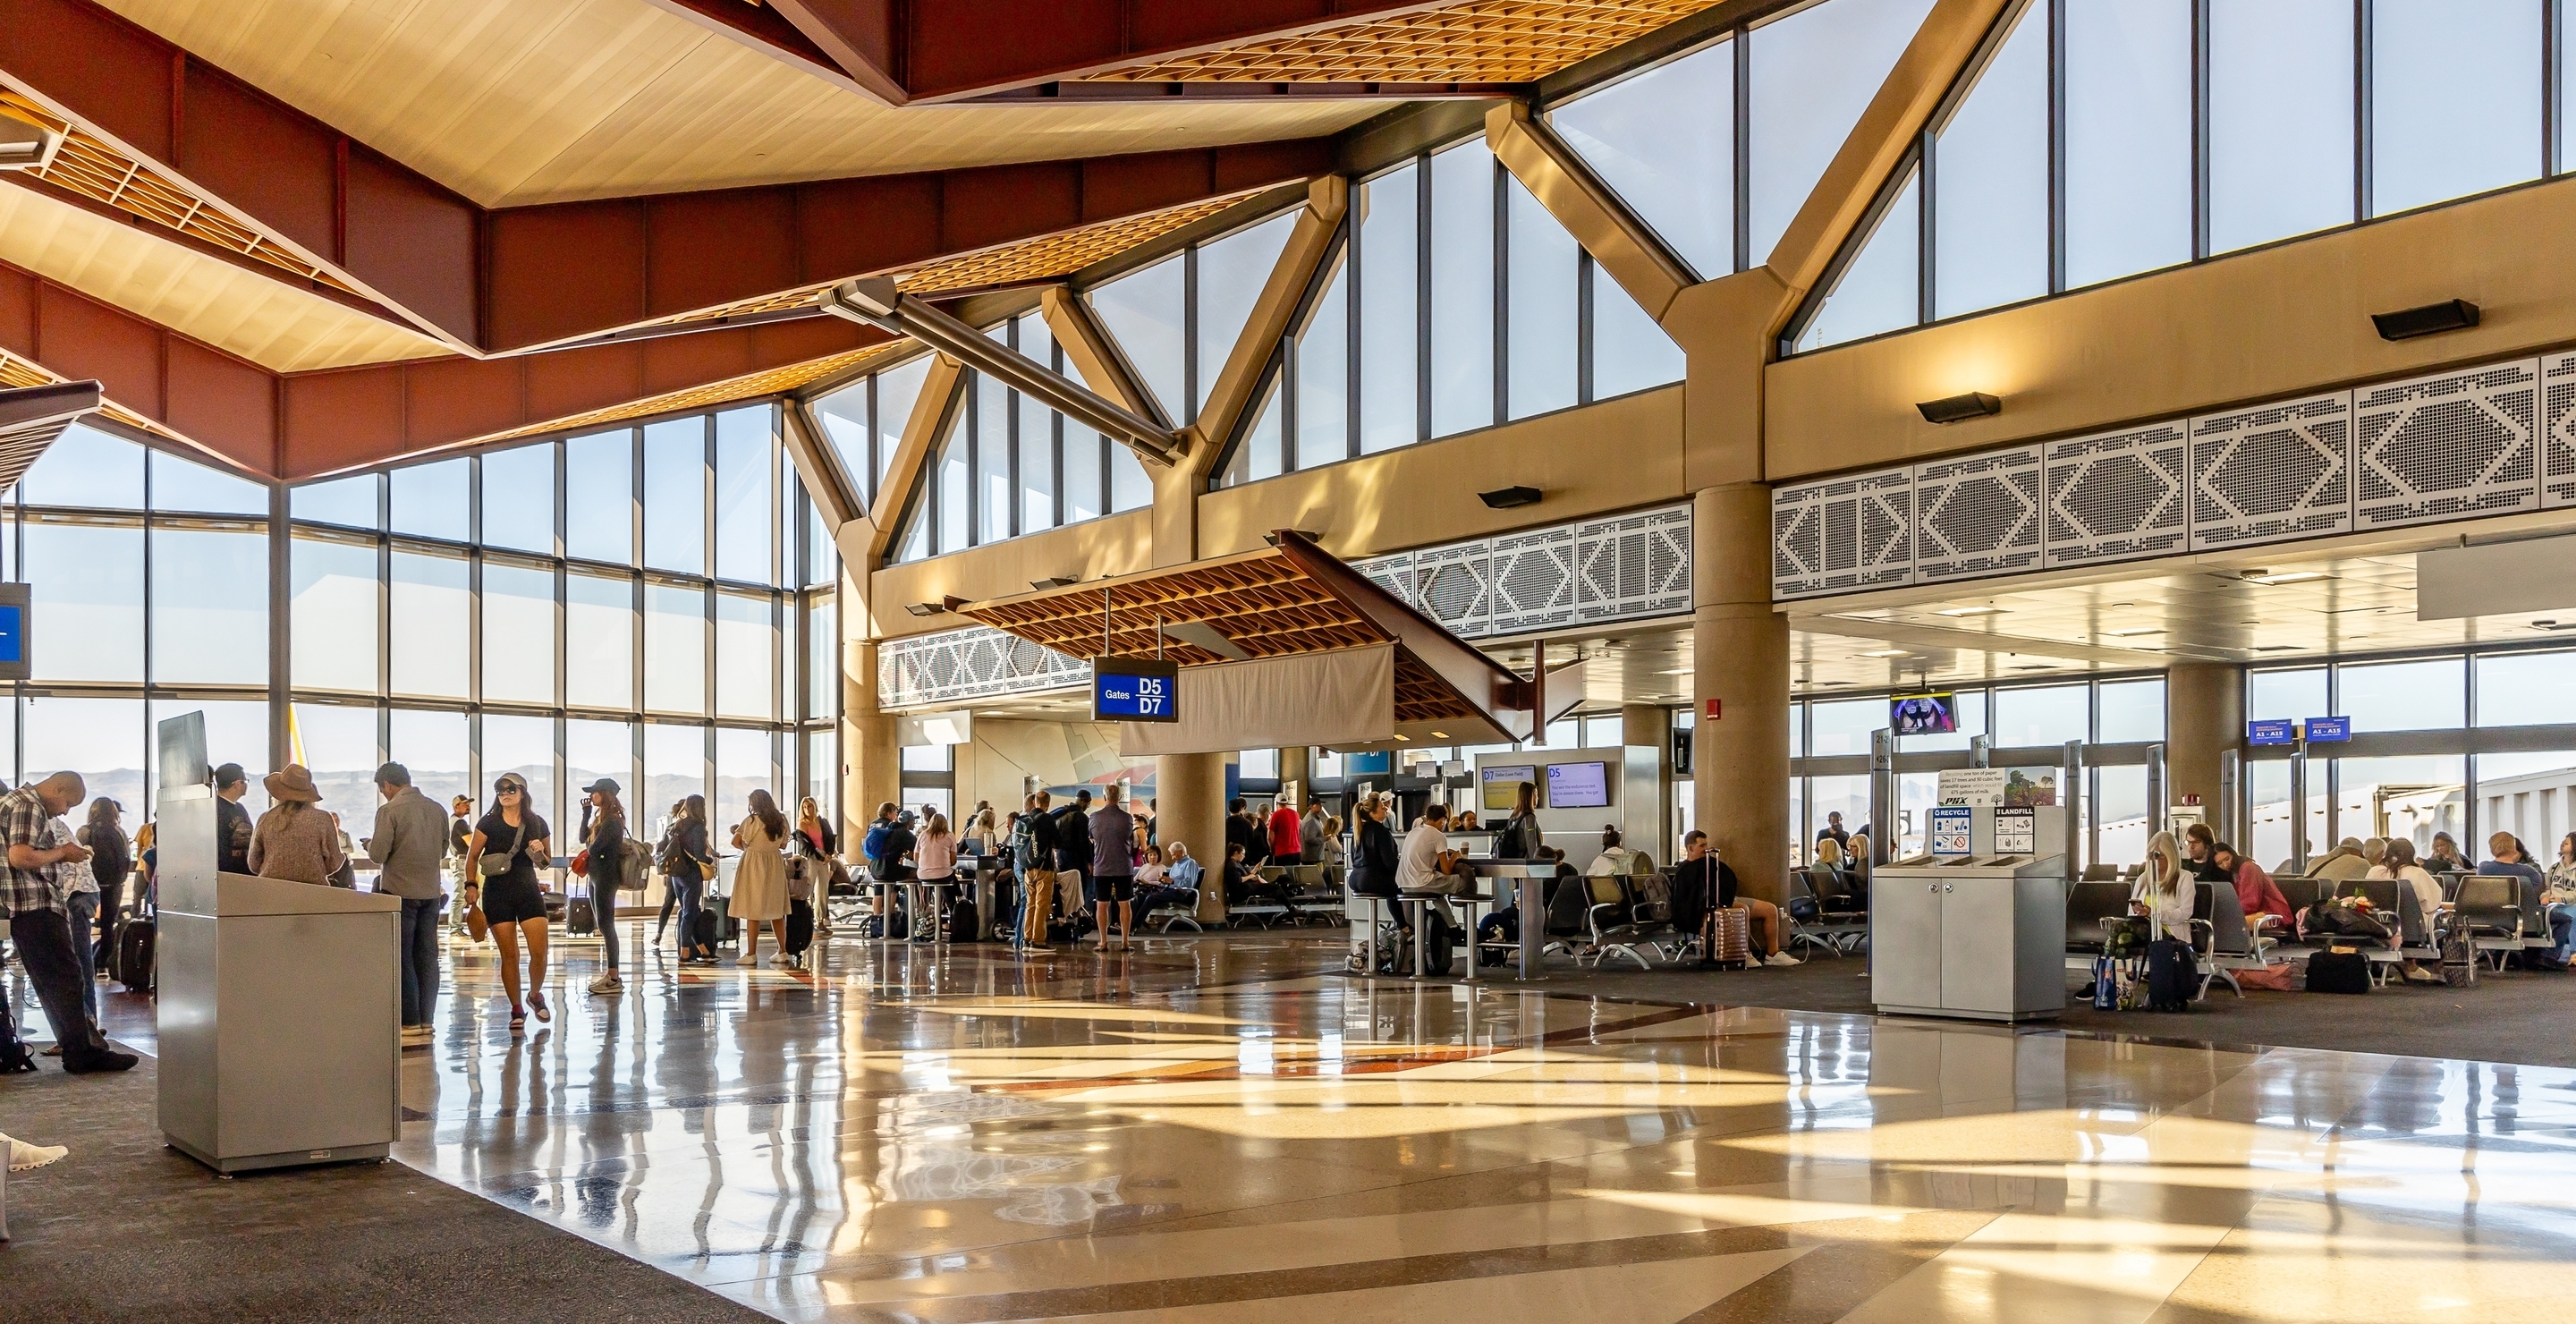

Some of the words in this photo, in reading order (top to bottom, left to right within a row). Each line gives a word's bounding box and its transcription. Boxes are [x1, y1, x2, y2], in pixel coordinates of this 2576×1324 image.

[1140, 677, 1162, 695] D5
[1105, 689, 1131, 700] Gates
[1140, 697, 1162, 714] D7
[1484, 770, 1494, 780] D7
[1549, 768, 1561, 777] D5
[1945, 797, 1969, 805] PHX
